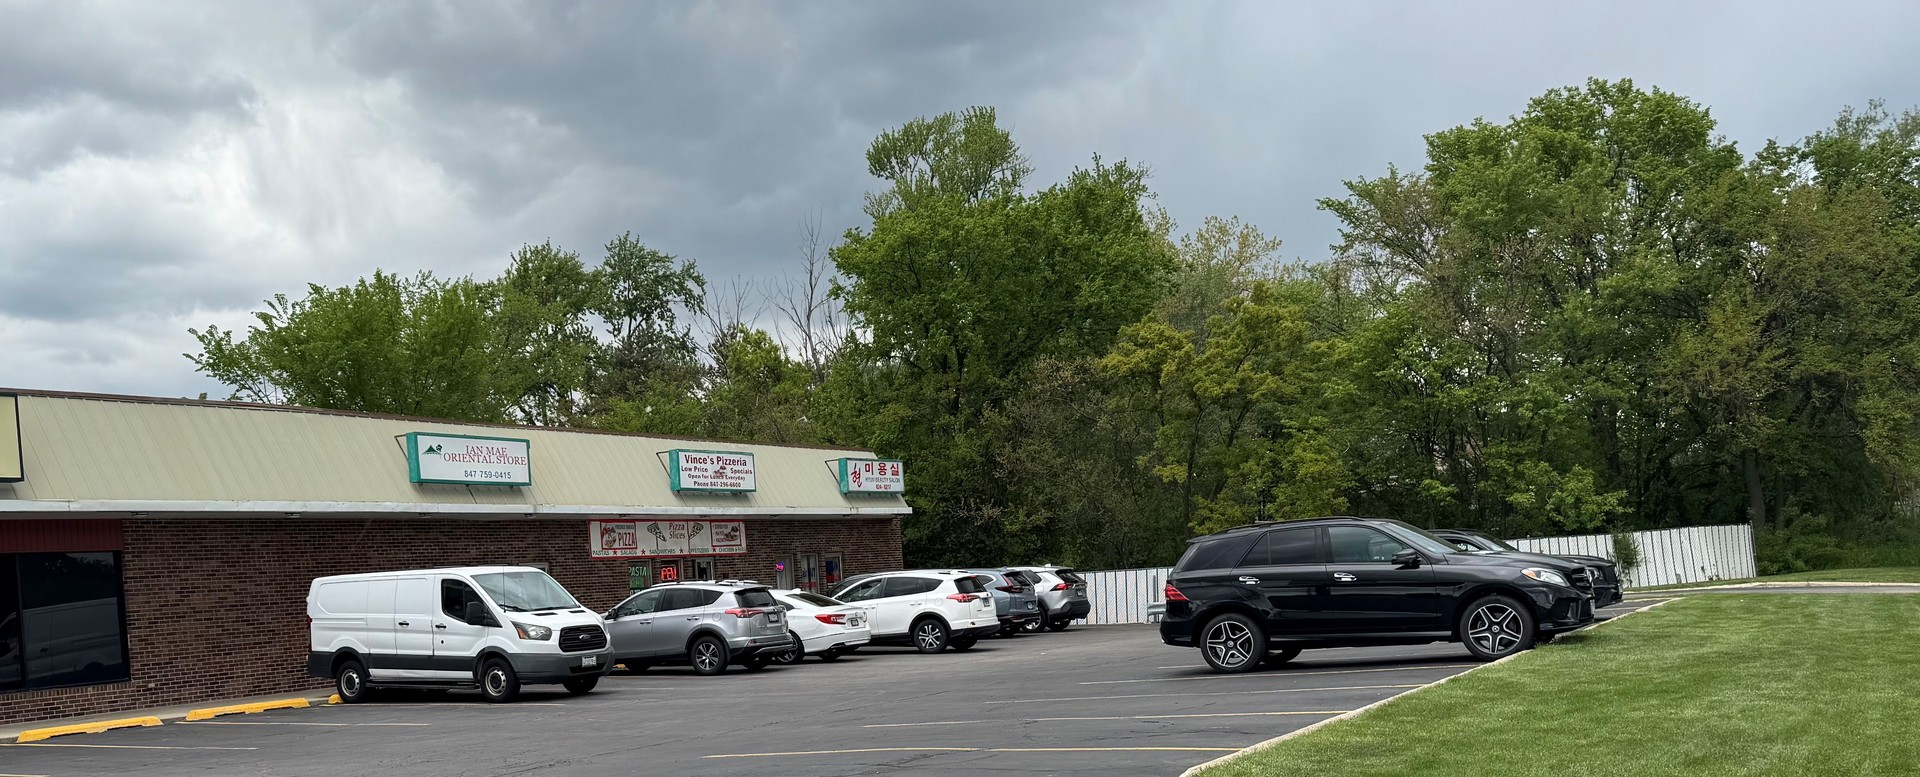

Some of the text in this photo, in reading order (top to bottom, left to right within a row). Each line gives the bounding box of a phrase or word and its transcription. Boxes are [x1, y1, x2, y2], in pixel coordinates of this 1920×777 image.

[486, 446, 507, 456] MAE
[443, 452, 527, 465] ORIENTAL STORE
[684, 454, 747, 467] Vince's Pizzeria
[617, 532, 636, 546] PIZZA
[669, 530, 686, 539] Slices
[628, 566, 647, 577] PASTA
